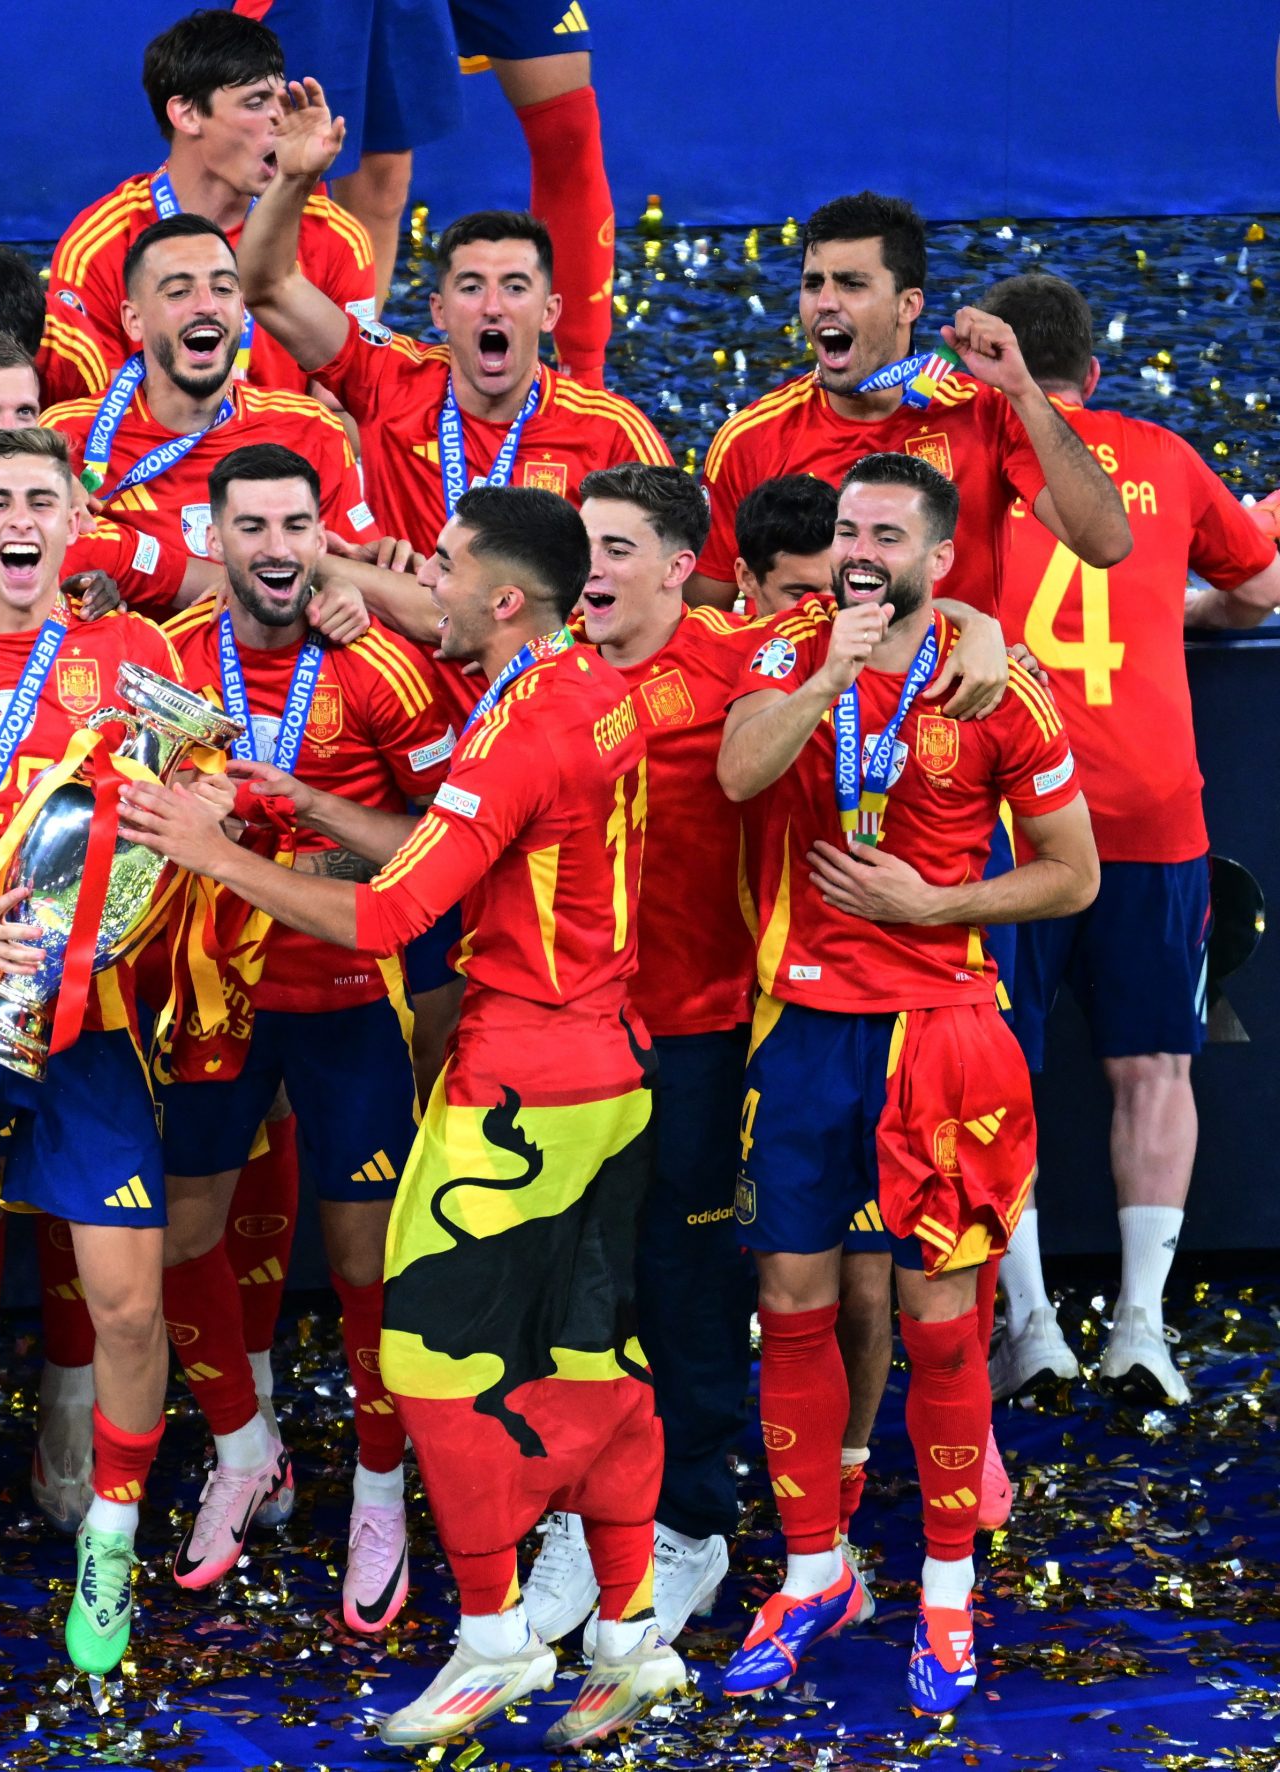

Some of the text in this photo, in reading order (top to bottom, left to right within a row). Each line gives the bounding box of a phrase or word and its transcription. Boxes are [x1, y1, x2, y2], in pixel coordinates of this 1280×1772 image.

[1023, 543, 1126, 707] 4
[593, 695, 638, 757] FERRAN
[739, 1087, 761, 1161] 4
